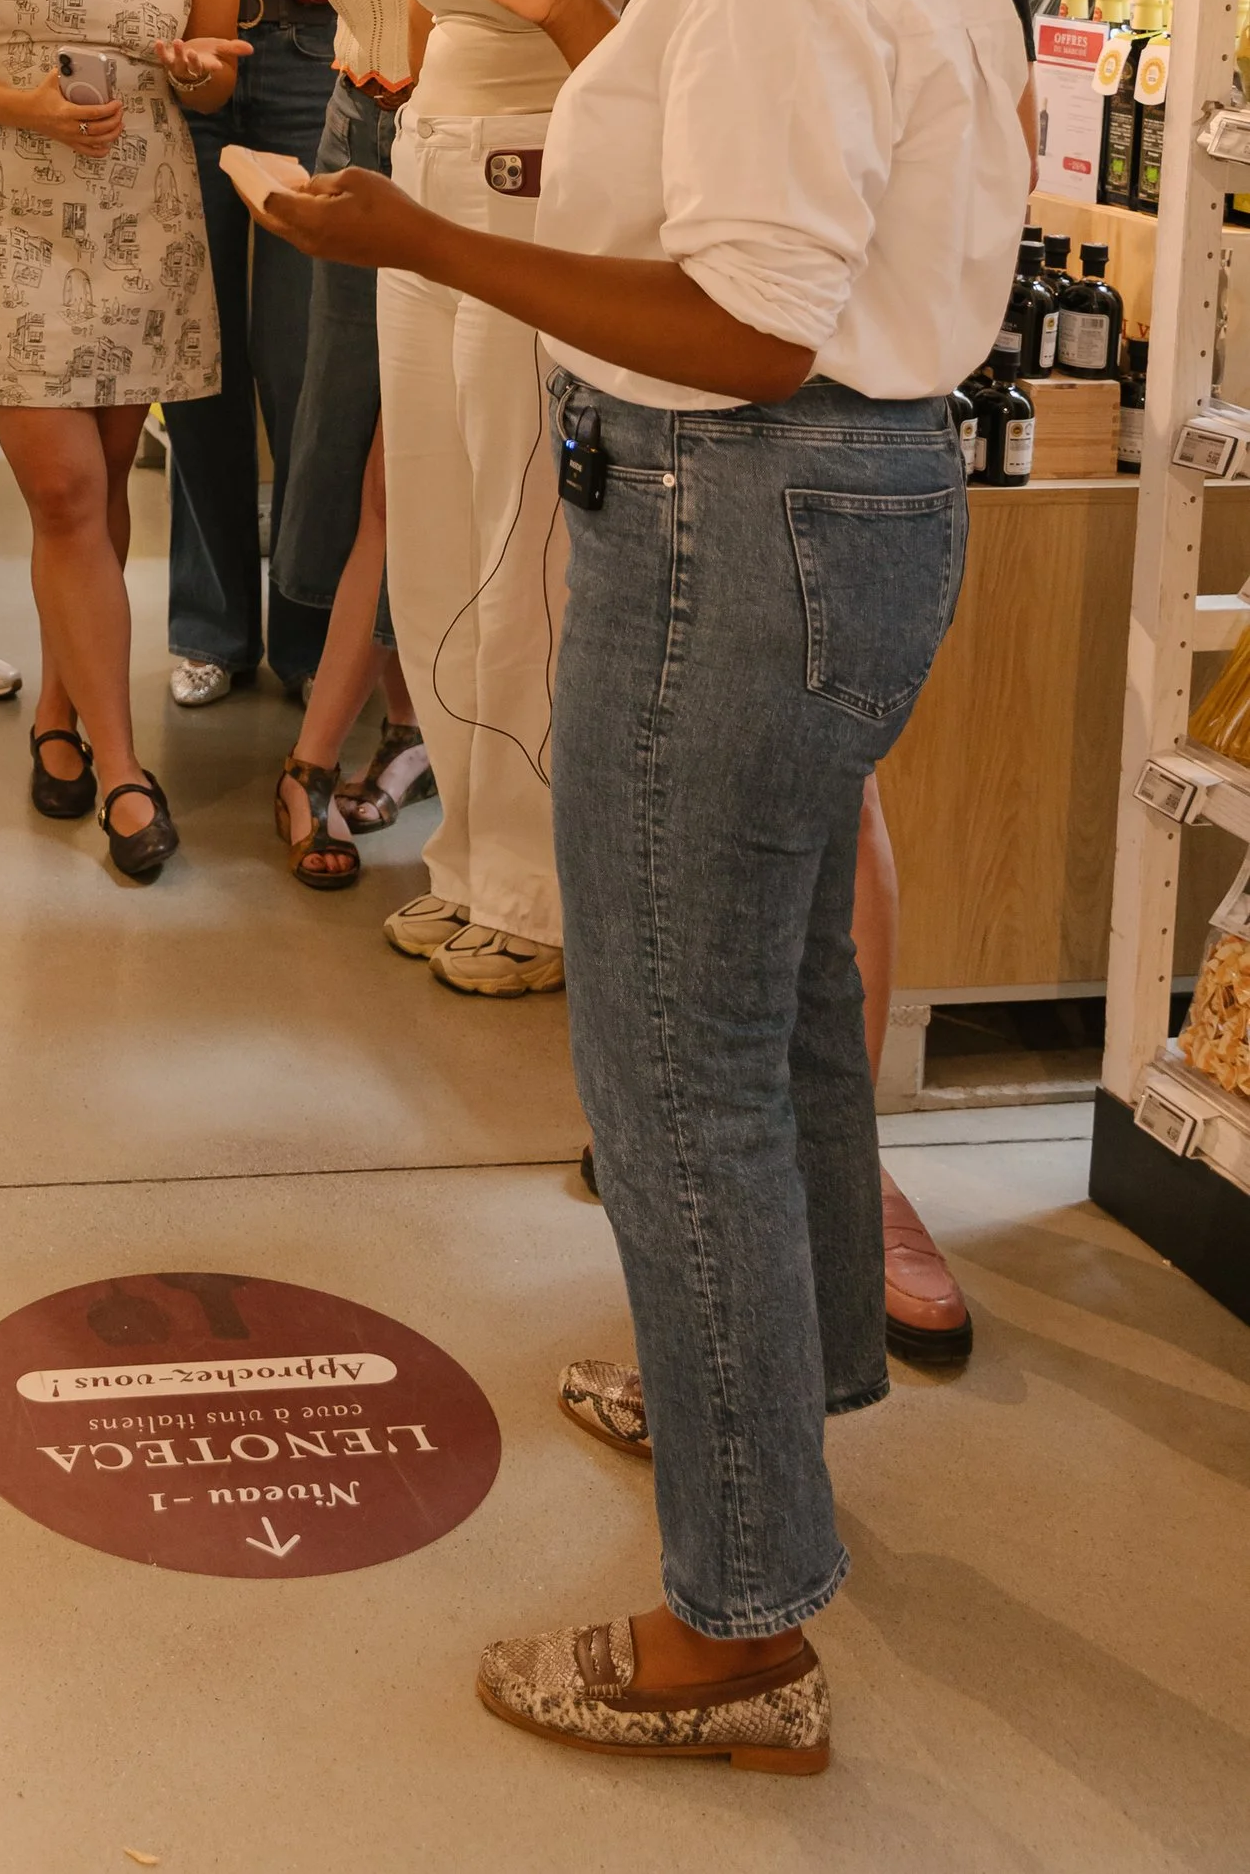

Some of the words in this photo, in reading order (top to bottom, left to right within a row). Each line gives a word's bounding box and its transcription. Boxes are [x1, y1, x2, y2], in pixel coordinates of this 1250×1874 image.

[1053, 32, 1088, 48] OFFRES
[74, 1356, 366, 1389] Approchez-vous
[206, 1409, 264, 1427] vins
[273, 1408, 291, 1424] à
[302, 1403, 363, 1419] cave
[88, 1413, 196, 1434] italiens
[35, 1423, 439, 1474] L'ENOTECA
[207, 1480, 361, 1507] Niveau
